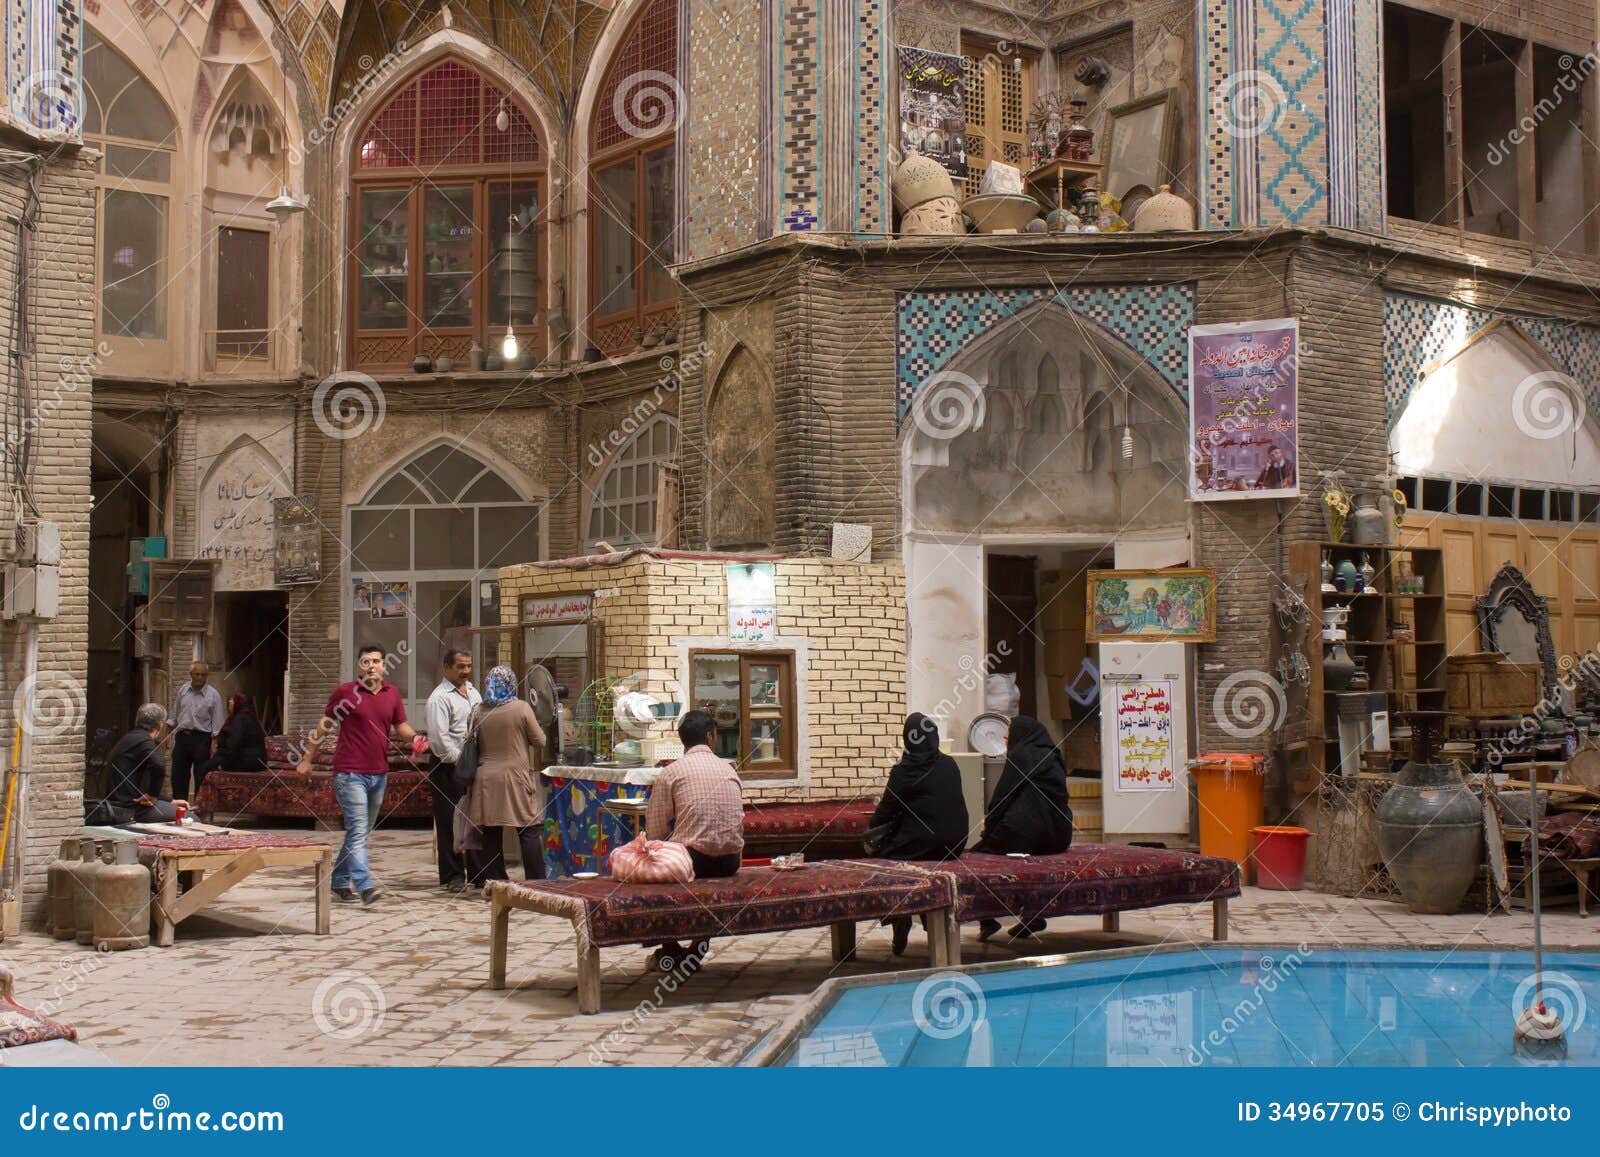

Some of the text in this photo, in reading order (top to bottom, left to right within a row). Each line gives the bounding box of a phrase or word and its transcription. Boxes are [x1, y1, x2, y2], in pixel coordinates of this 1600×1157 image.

[736, 615, 773, 631] امین الدوله
[730, 630, 764, 641] خوش آمدید
